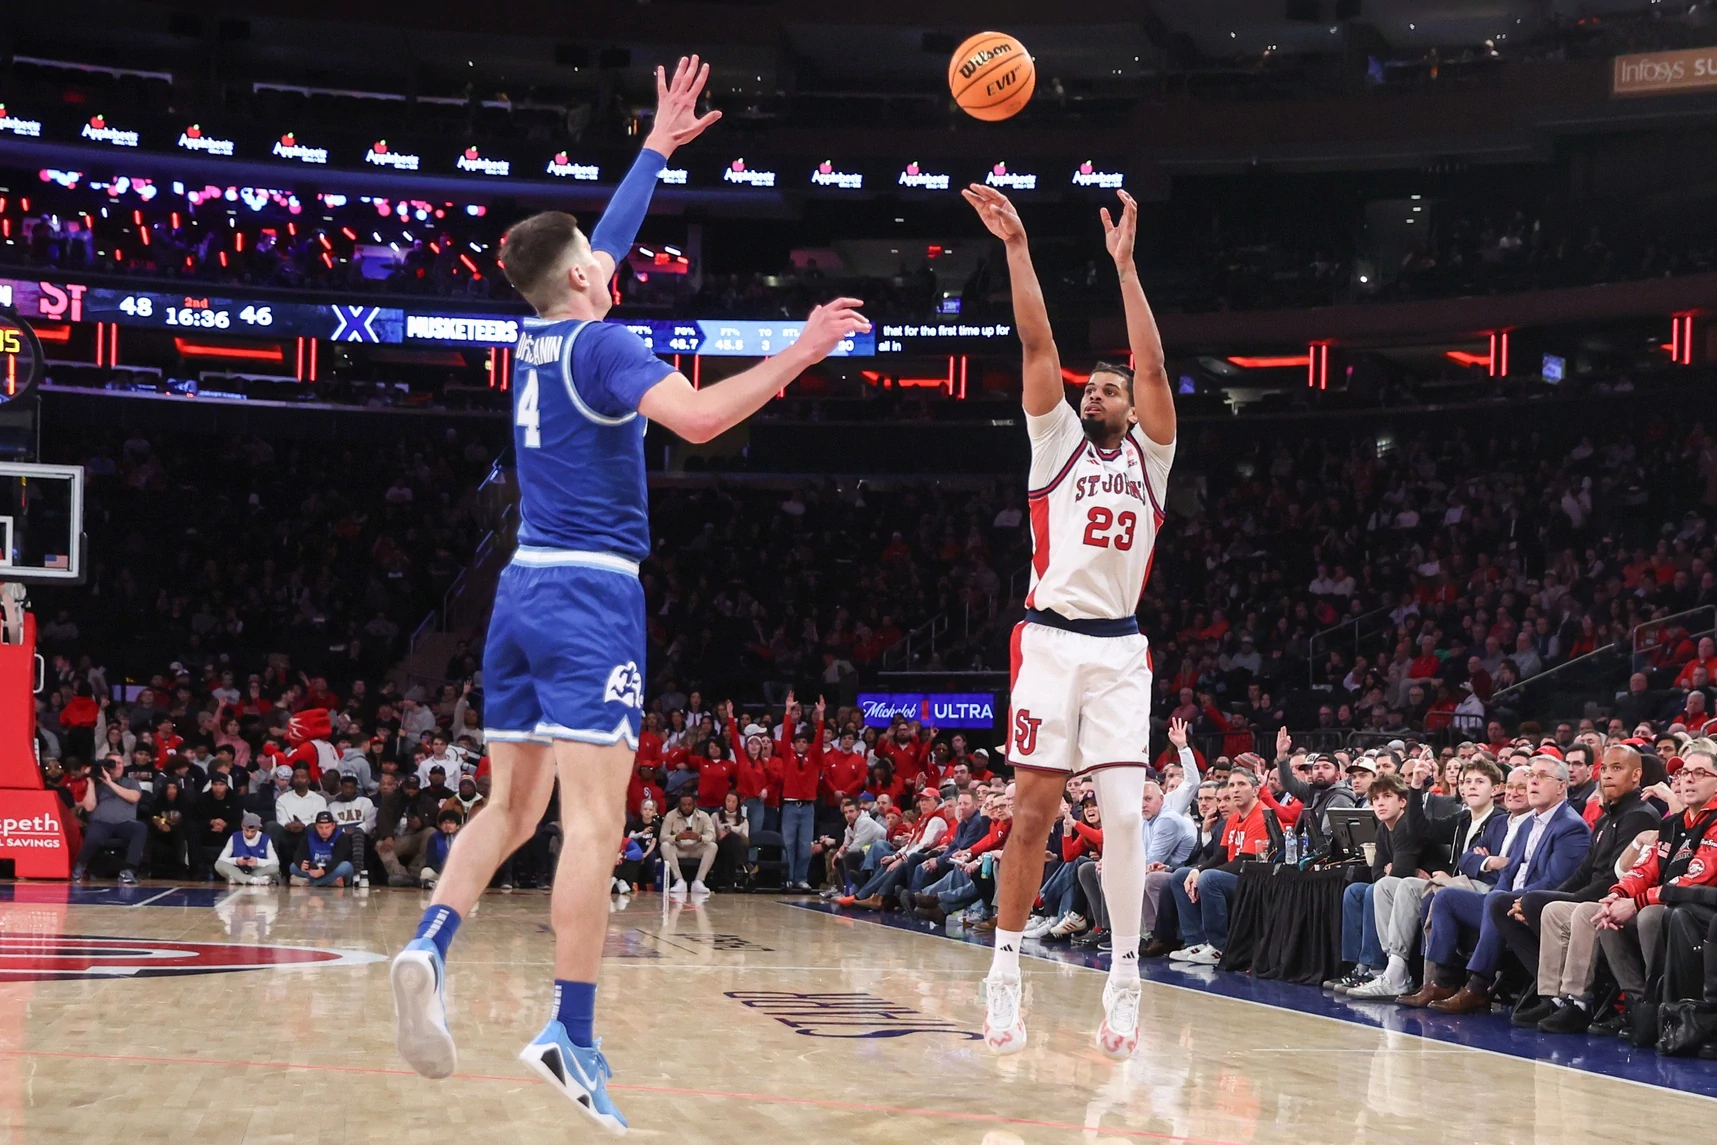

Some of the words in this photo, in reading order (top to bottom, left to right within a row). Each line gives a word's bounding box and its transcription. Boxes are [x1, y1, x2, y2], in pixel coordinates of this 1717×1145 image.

[959, 43, 1012, 79] Wilson
[1621, 58, 1685, 84] Infosys
[119, 296, 153, 317] 48
[184, 296, 209, 309] 2nd
[165, 307, 230, 329] 16:36
[239, 305, 273, 326] 46
[406, 315, 518, 343] MUSKETEERS
[758, 328, 772, 337] TO
[883, 325, 902, 337] that
[904, 325, 919, 337] for
[920, 325, 937, 337] the
[938, 325, 957, 337] first
[958, 325, 980, 337] time
[981, 326, 995, 338] up
[995, 324, 1010, 336] for
[761, 339, 771, 351] 3
[878, 341, 891, 352] all
[892, 341, 902, 352] in
[516, 368, 541, 448] 4
[1083, 506, 1137, 551] 23
[934, 703, 993, 719] ULTRA
[6, 838, 60, 848] SAVINGS
